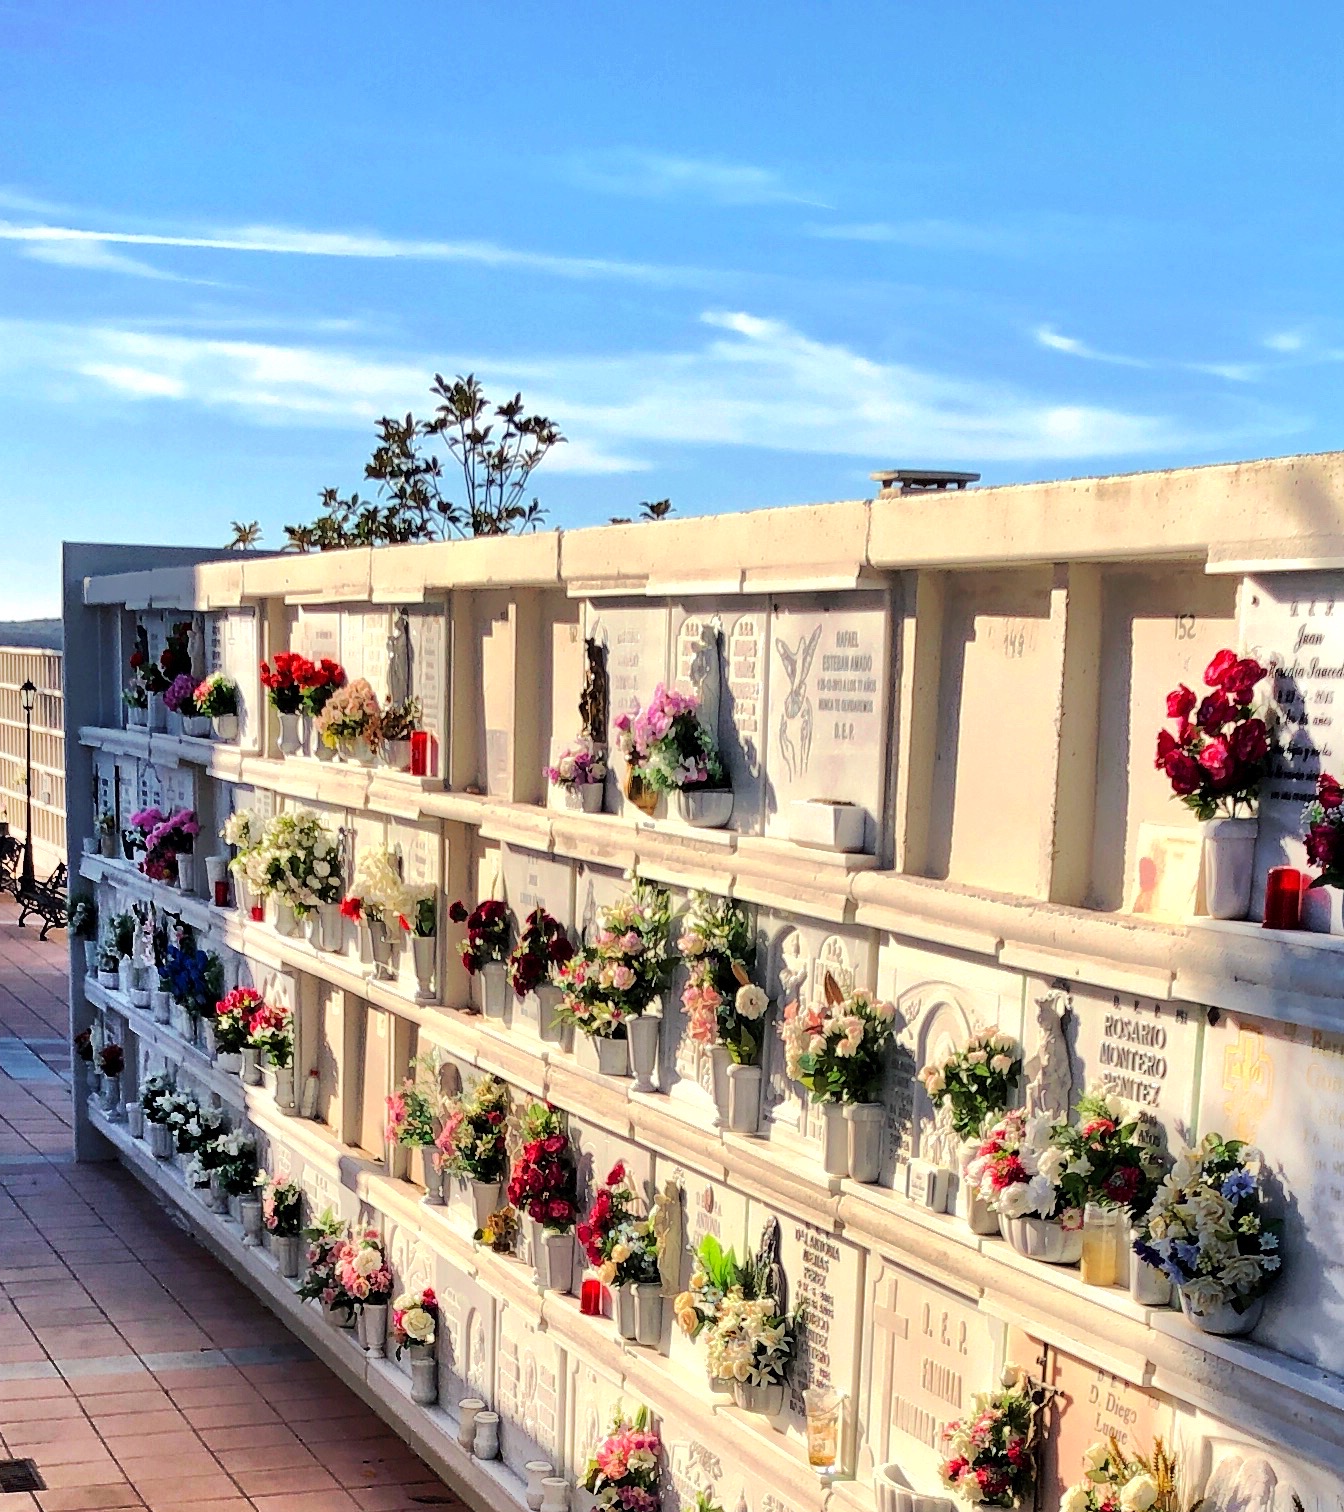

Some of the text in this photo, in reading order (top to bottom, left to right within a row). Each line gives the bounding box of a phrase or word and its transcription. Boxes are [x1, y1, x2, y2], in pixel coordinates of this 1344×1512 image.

[836, 630, 859, 648] RAFAEL
[1104, 1013, 1168, 1050] ROSARIO
[1099, 1040, 1168, 1080] MONTERO
[1103, 1070, 1163, 1108] BENITEZ
[1106, 1391, 1137, 1425] Diego
